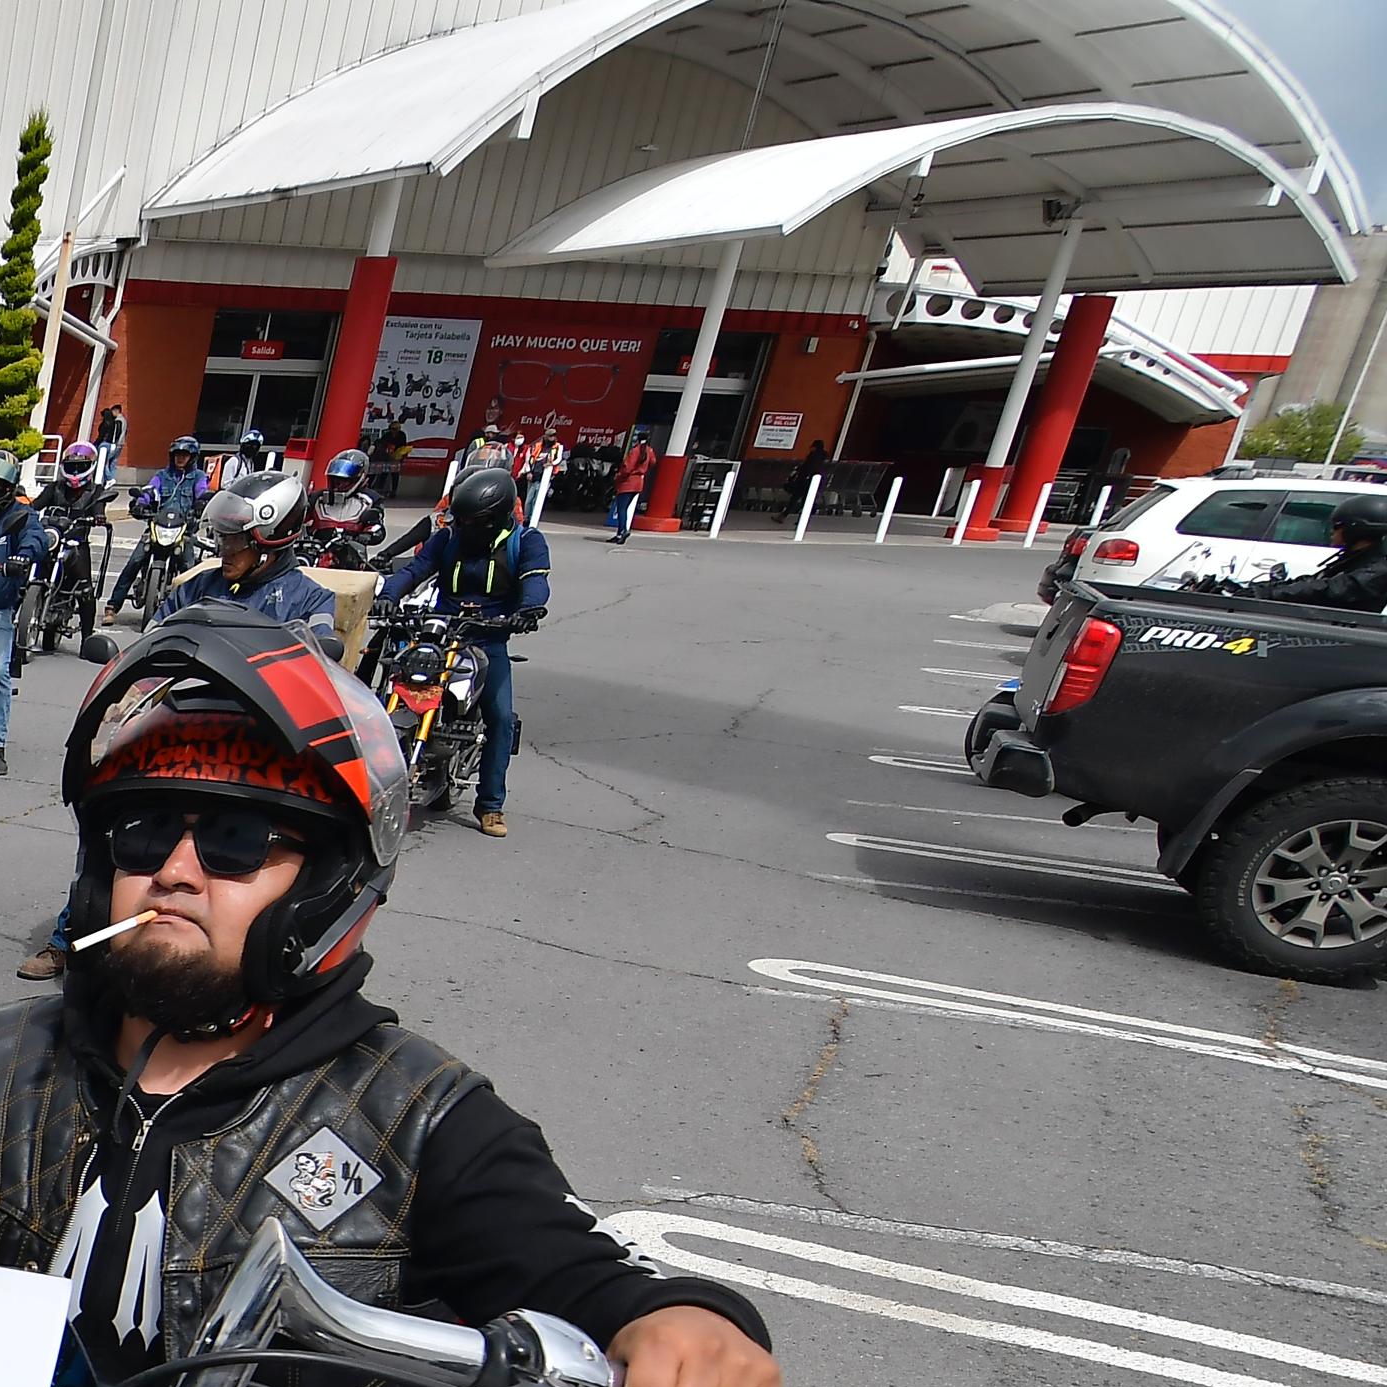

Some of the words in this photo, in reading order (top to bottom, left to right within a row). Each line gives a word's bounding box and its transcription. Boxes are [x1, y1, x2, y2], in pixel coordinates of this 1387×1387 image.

[405, 331, 433, 341] Tarjeta
[434, 332, 471, 341] Falabella
[491, 334, 524, 349] ¡HAY
[527, 336, 577, 350] MUCHO
[579, 338, 609, 352] QUE
[612, 339, 642, 353] VER!
[251, 345, 276, 355] Salida
[427, 349, 444, 364] 18
